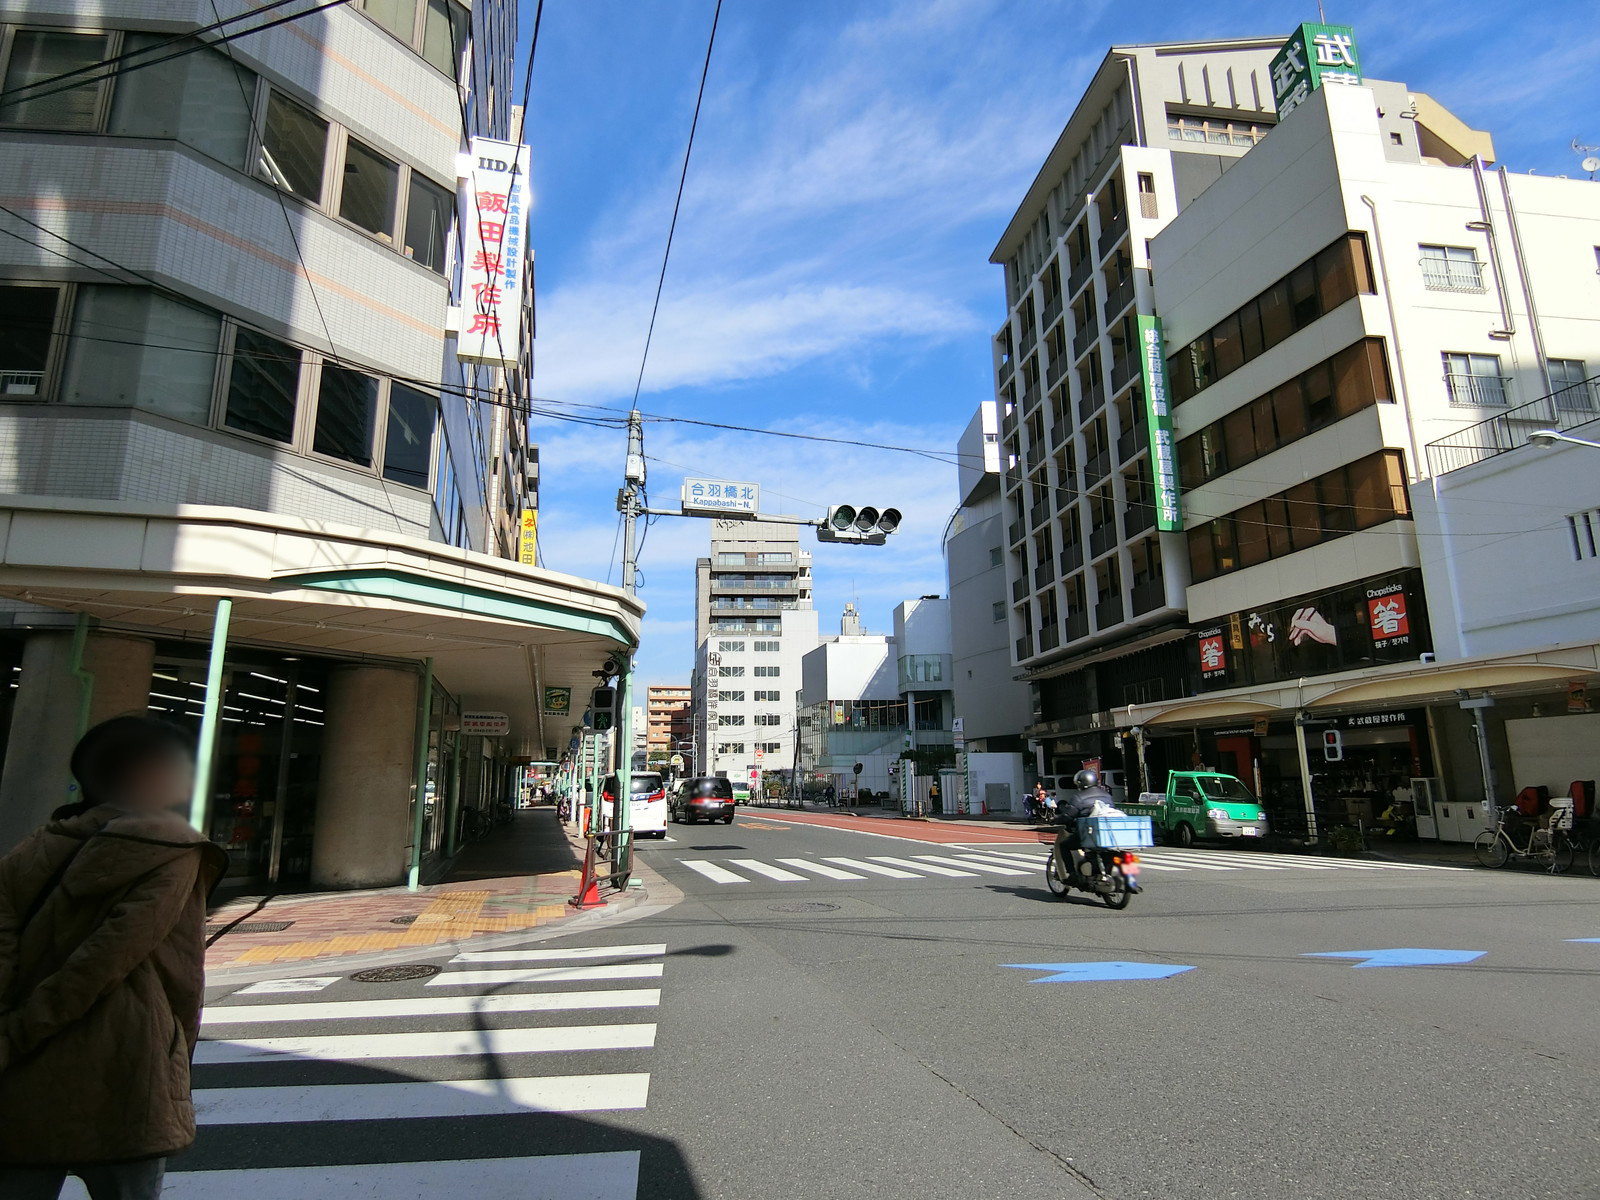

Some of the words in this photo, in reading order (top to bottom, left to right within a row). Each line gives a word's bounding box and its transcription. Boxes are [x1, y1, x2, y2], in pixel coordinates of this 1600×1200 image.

[478, 157, 522, 175] IIDA
[467, 190, 508, 338] 飯田製作所
[1144, 328, 1167, 417] 総合厨房設備
[1154, 429, 1177, 523] 武蔵屋製作所
[692, 483, 753, 500] 合羽橋北
[1367, 583, 1403, 598] Chopsticks
[1371, 598, 1407, 634] 箸
[1198, 628, 1222, 639] Chopsticks
[1201, 640, 1224, 668] 箸
